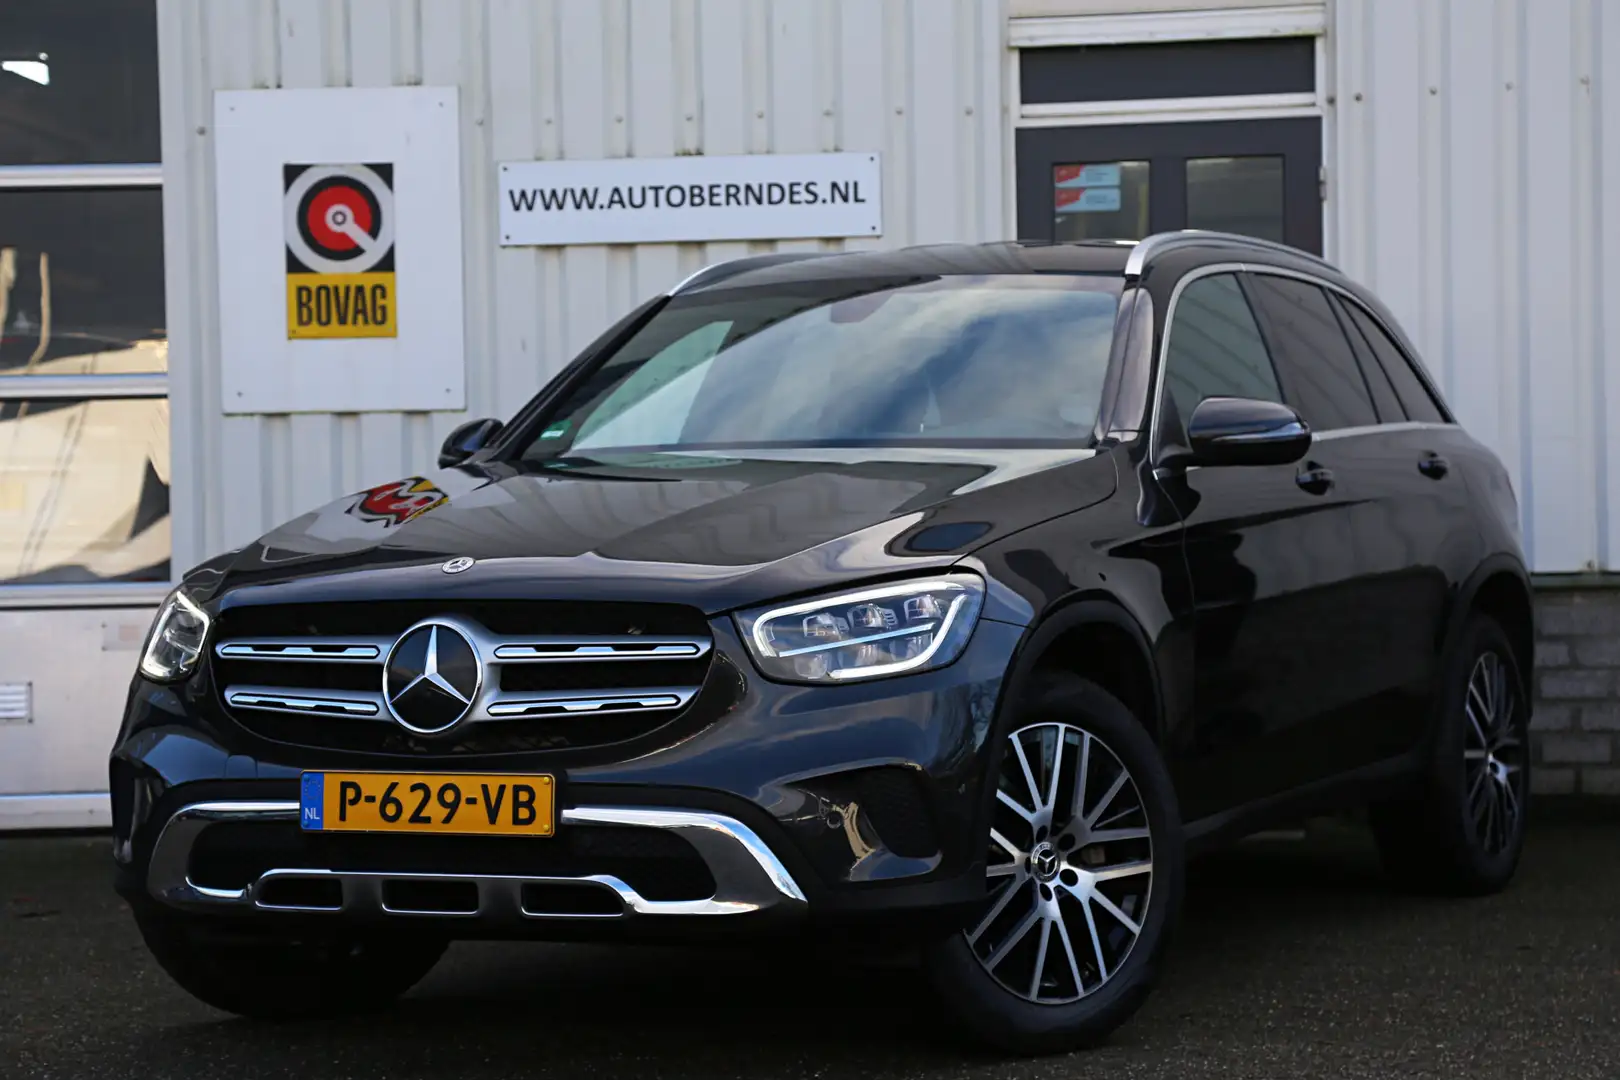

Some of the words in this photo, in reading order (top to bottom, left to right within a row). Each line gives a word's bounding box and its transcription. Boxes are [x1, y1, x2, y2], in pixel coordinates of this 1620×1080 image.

[508, 180, 866, 212] WWW.AUTOBERNDES.NL
[297, 284, 387, 326] BOVAG
[304, 807, 320, 820] NL
[338, 780, 537, 826] P-629-VB
